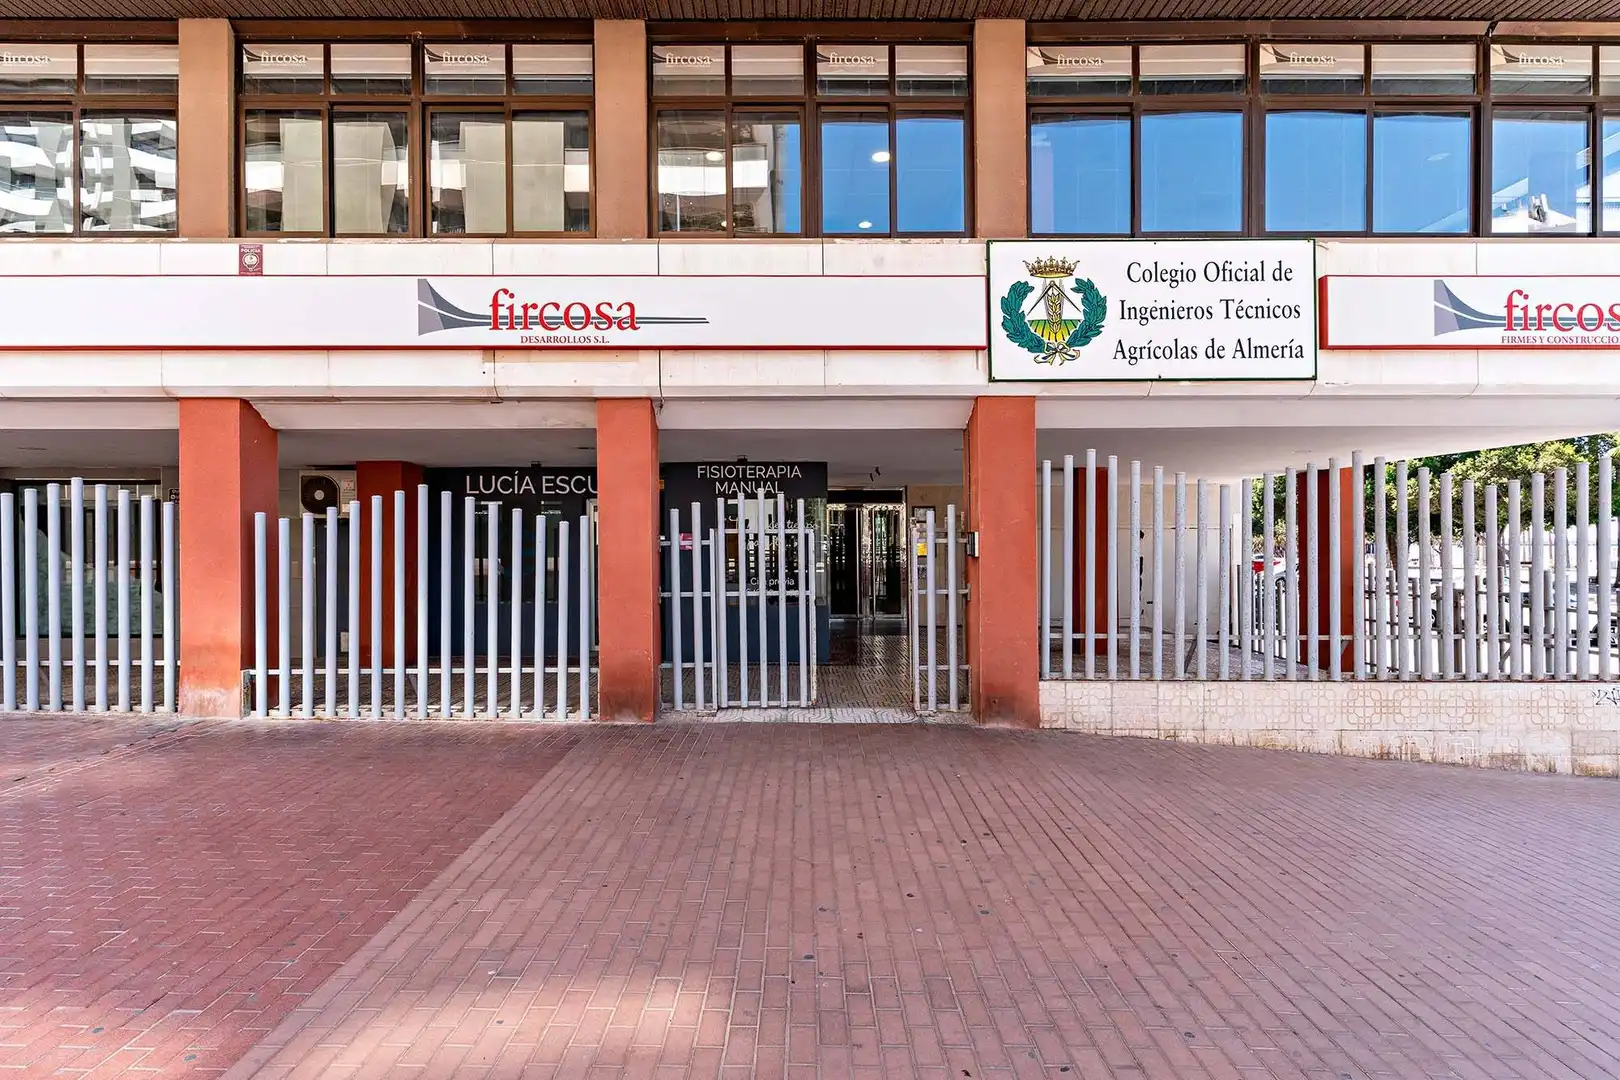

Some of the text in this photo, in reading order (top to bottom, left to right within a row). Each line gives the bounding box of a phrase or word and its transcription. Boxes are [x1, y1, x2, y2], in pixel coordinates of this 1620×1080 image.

[3, 51, 49, 64] fircosa
[260, 50, 307, 63] fircosa
[442, 51, 489, 64] fircosa
[665, 52, 712, 65] fircosa
[829, 51, 875, 65] fircosa
[1057, 53, 1103, 66] fircosa
[1289, 51, 1335, 64] fircosa
[1519, 52, 1565, 66] fircosa
[1126, 260, 1293, 288] Colegio Oficial de
[488, 288, 641, 331] fircosa
[1119, 298, 1301, 326] Ingenieros Técnicos
[1503, 289, 1620, 332] fircos
[520, 335, 610, 344] DESARROLLOS S.L.
[1501, 335, 1537, 344] FIRMES
[1538, 335, 1545, 344] Y
[1112, 337, 1305, 366] Agrícolas de Almería
[696, 465, 802, 479] FISIOTERAPIA
[466, 470, 536, 494] LUCÍA
[715, 481, 785, 494] MANUAL
